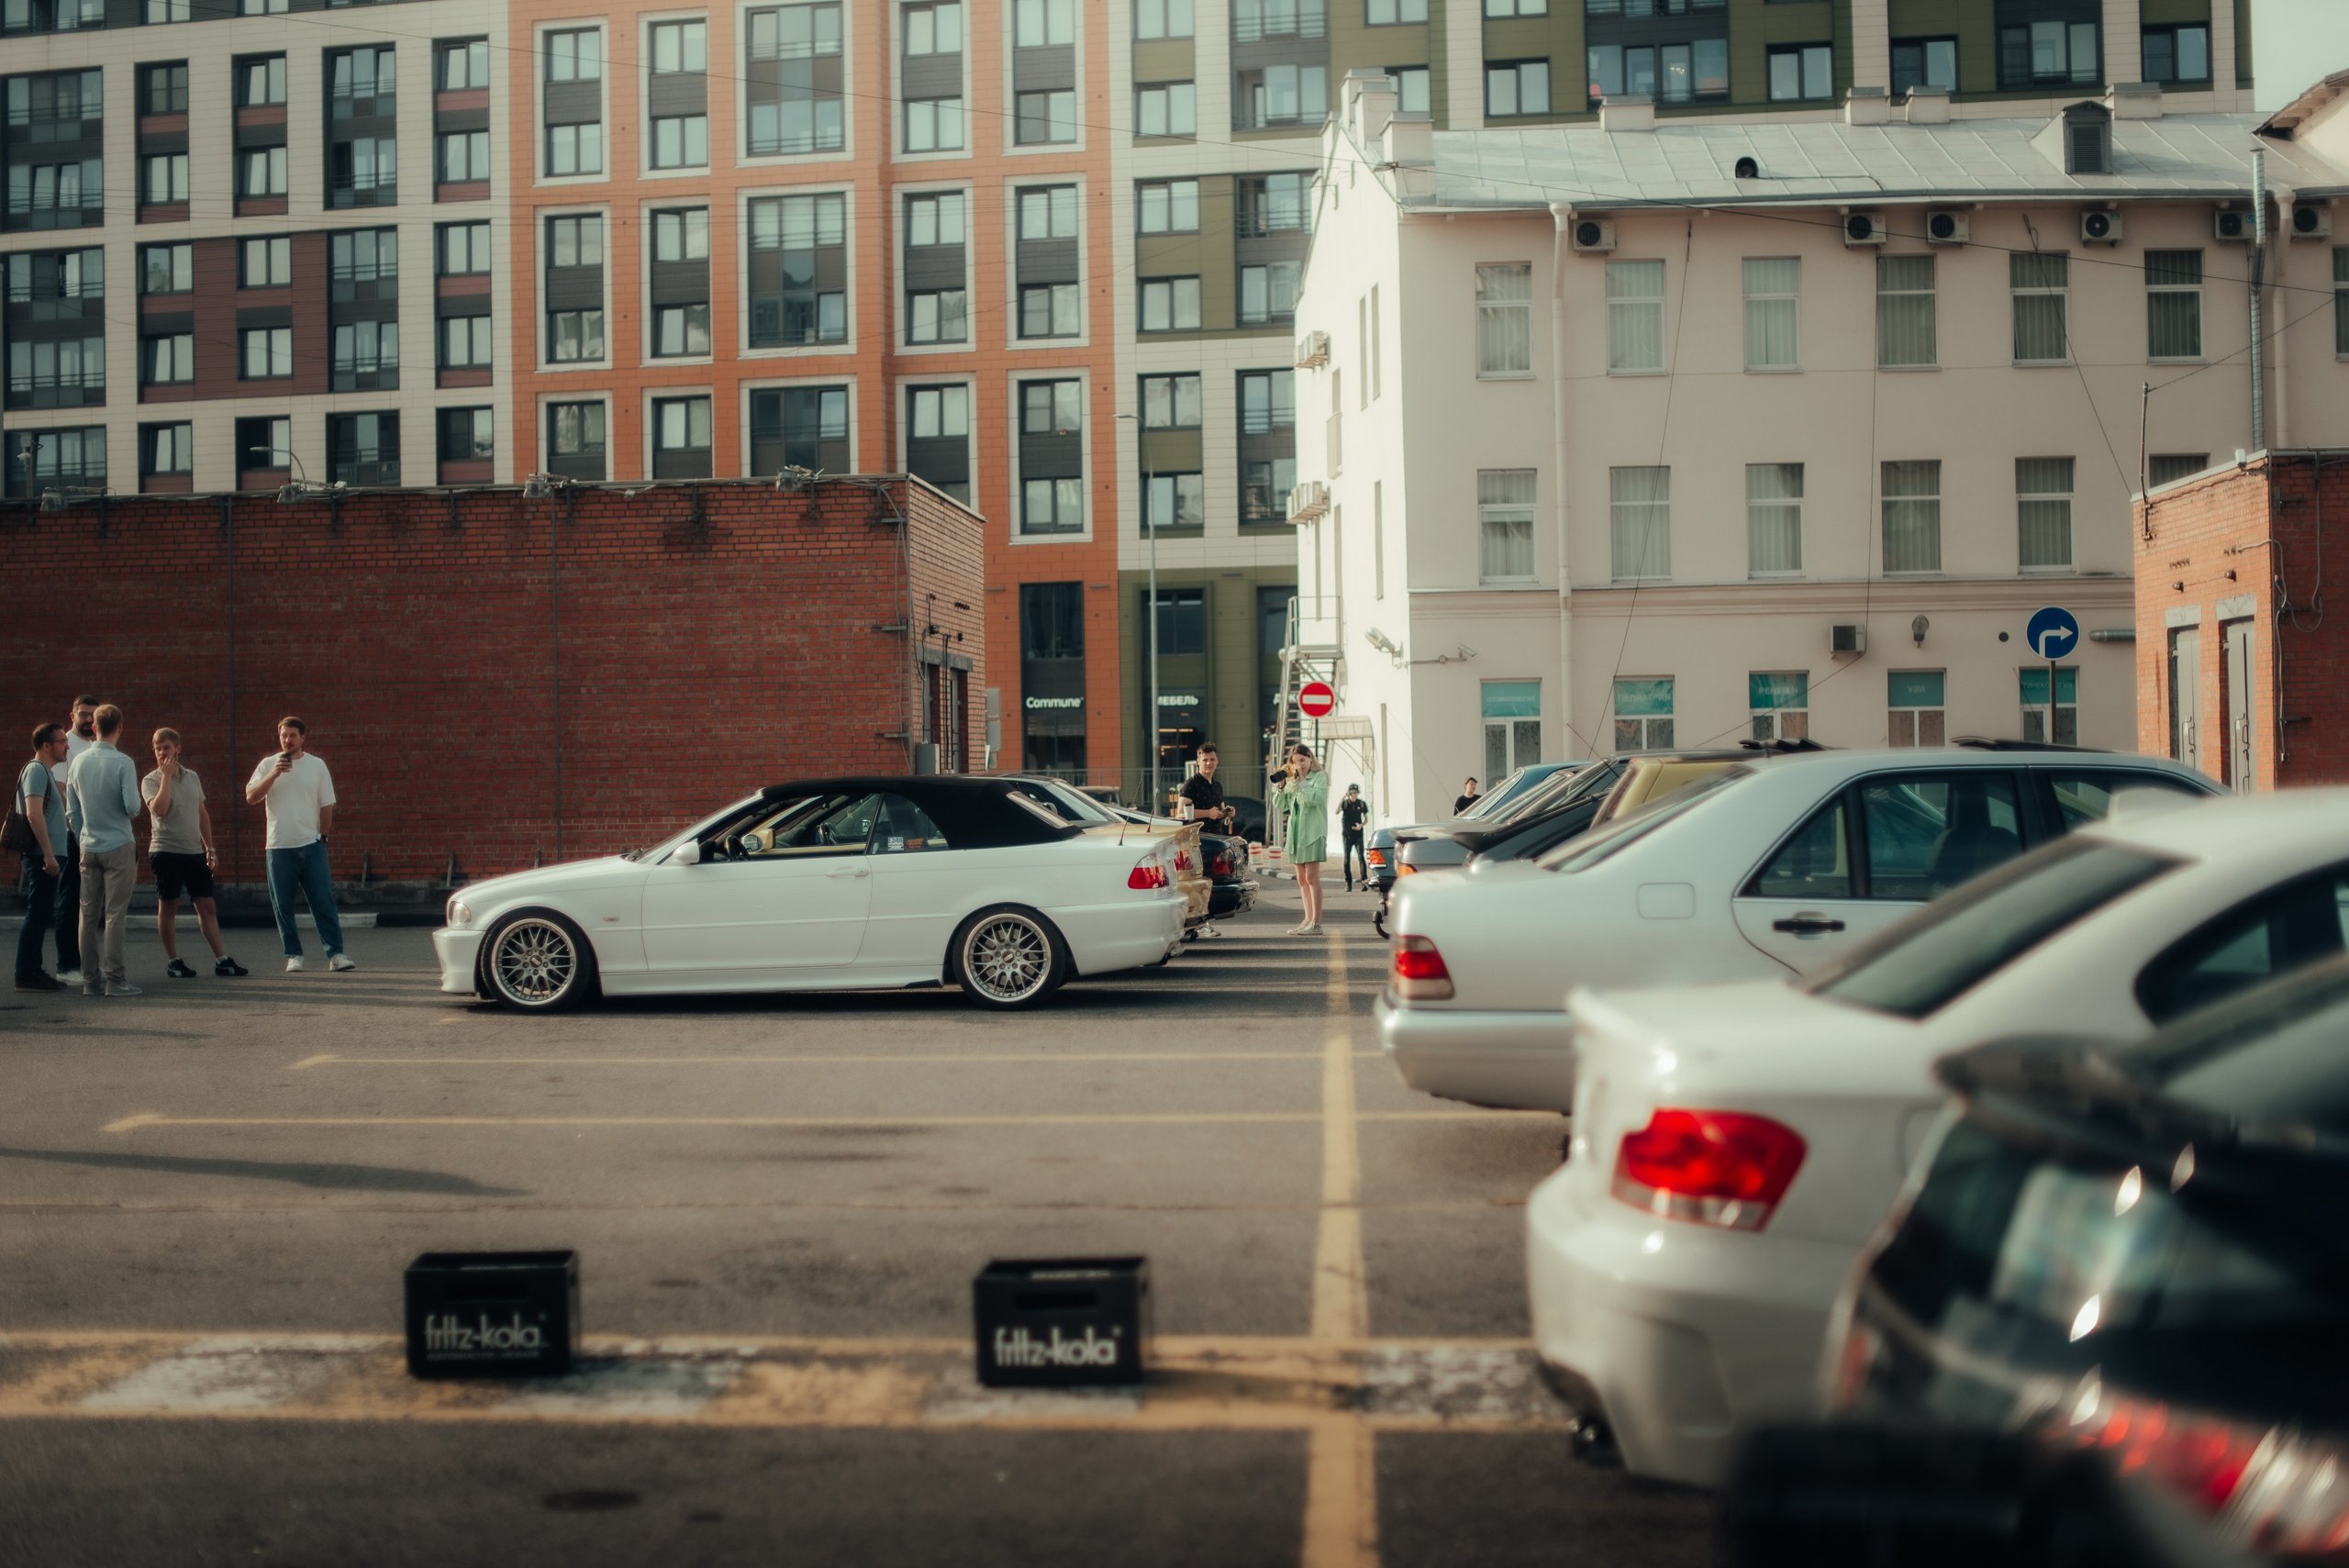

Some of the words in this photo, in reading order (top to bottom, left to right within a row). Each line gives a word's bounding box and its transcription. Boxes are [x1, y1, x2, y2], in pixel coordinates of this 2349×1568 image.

[1908, 684, 1926, 694] УЗИ
[1026, 696, 1081, 708] Commune
[1618, 693, 1672, 703] ПЕДИАТРИЯ
[424, 1313, 540, 1350] fritz-kola
[994, 1326, 1117, 1366] fritz-kola
